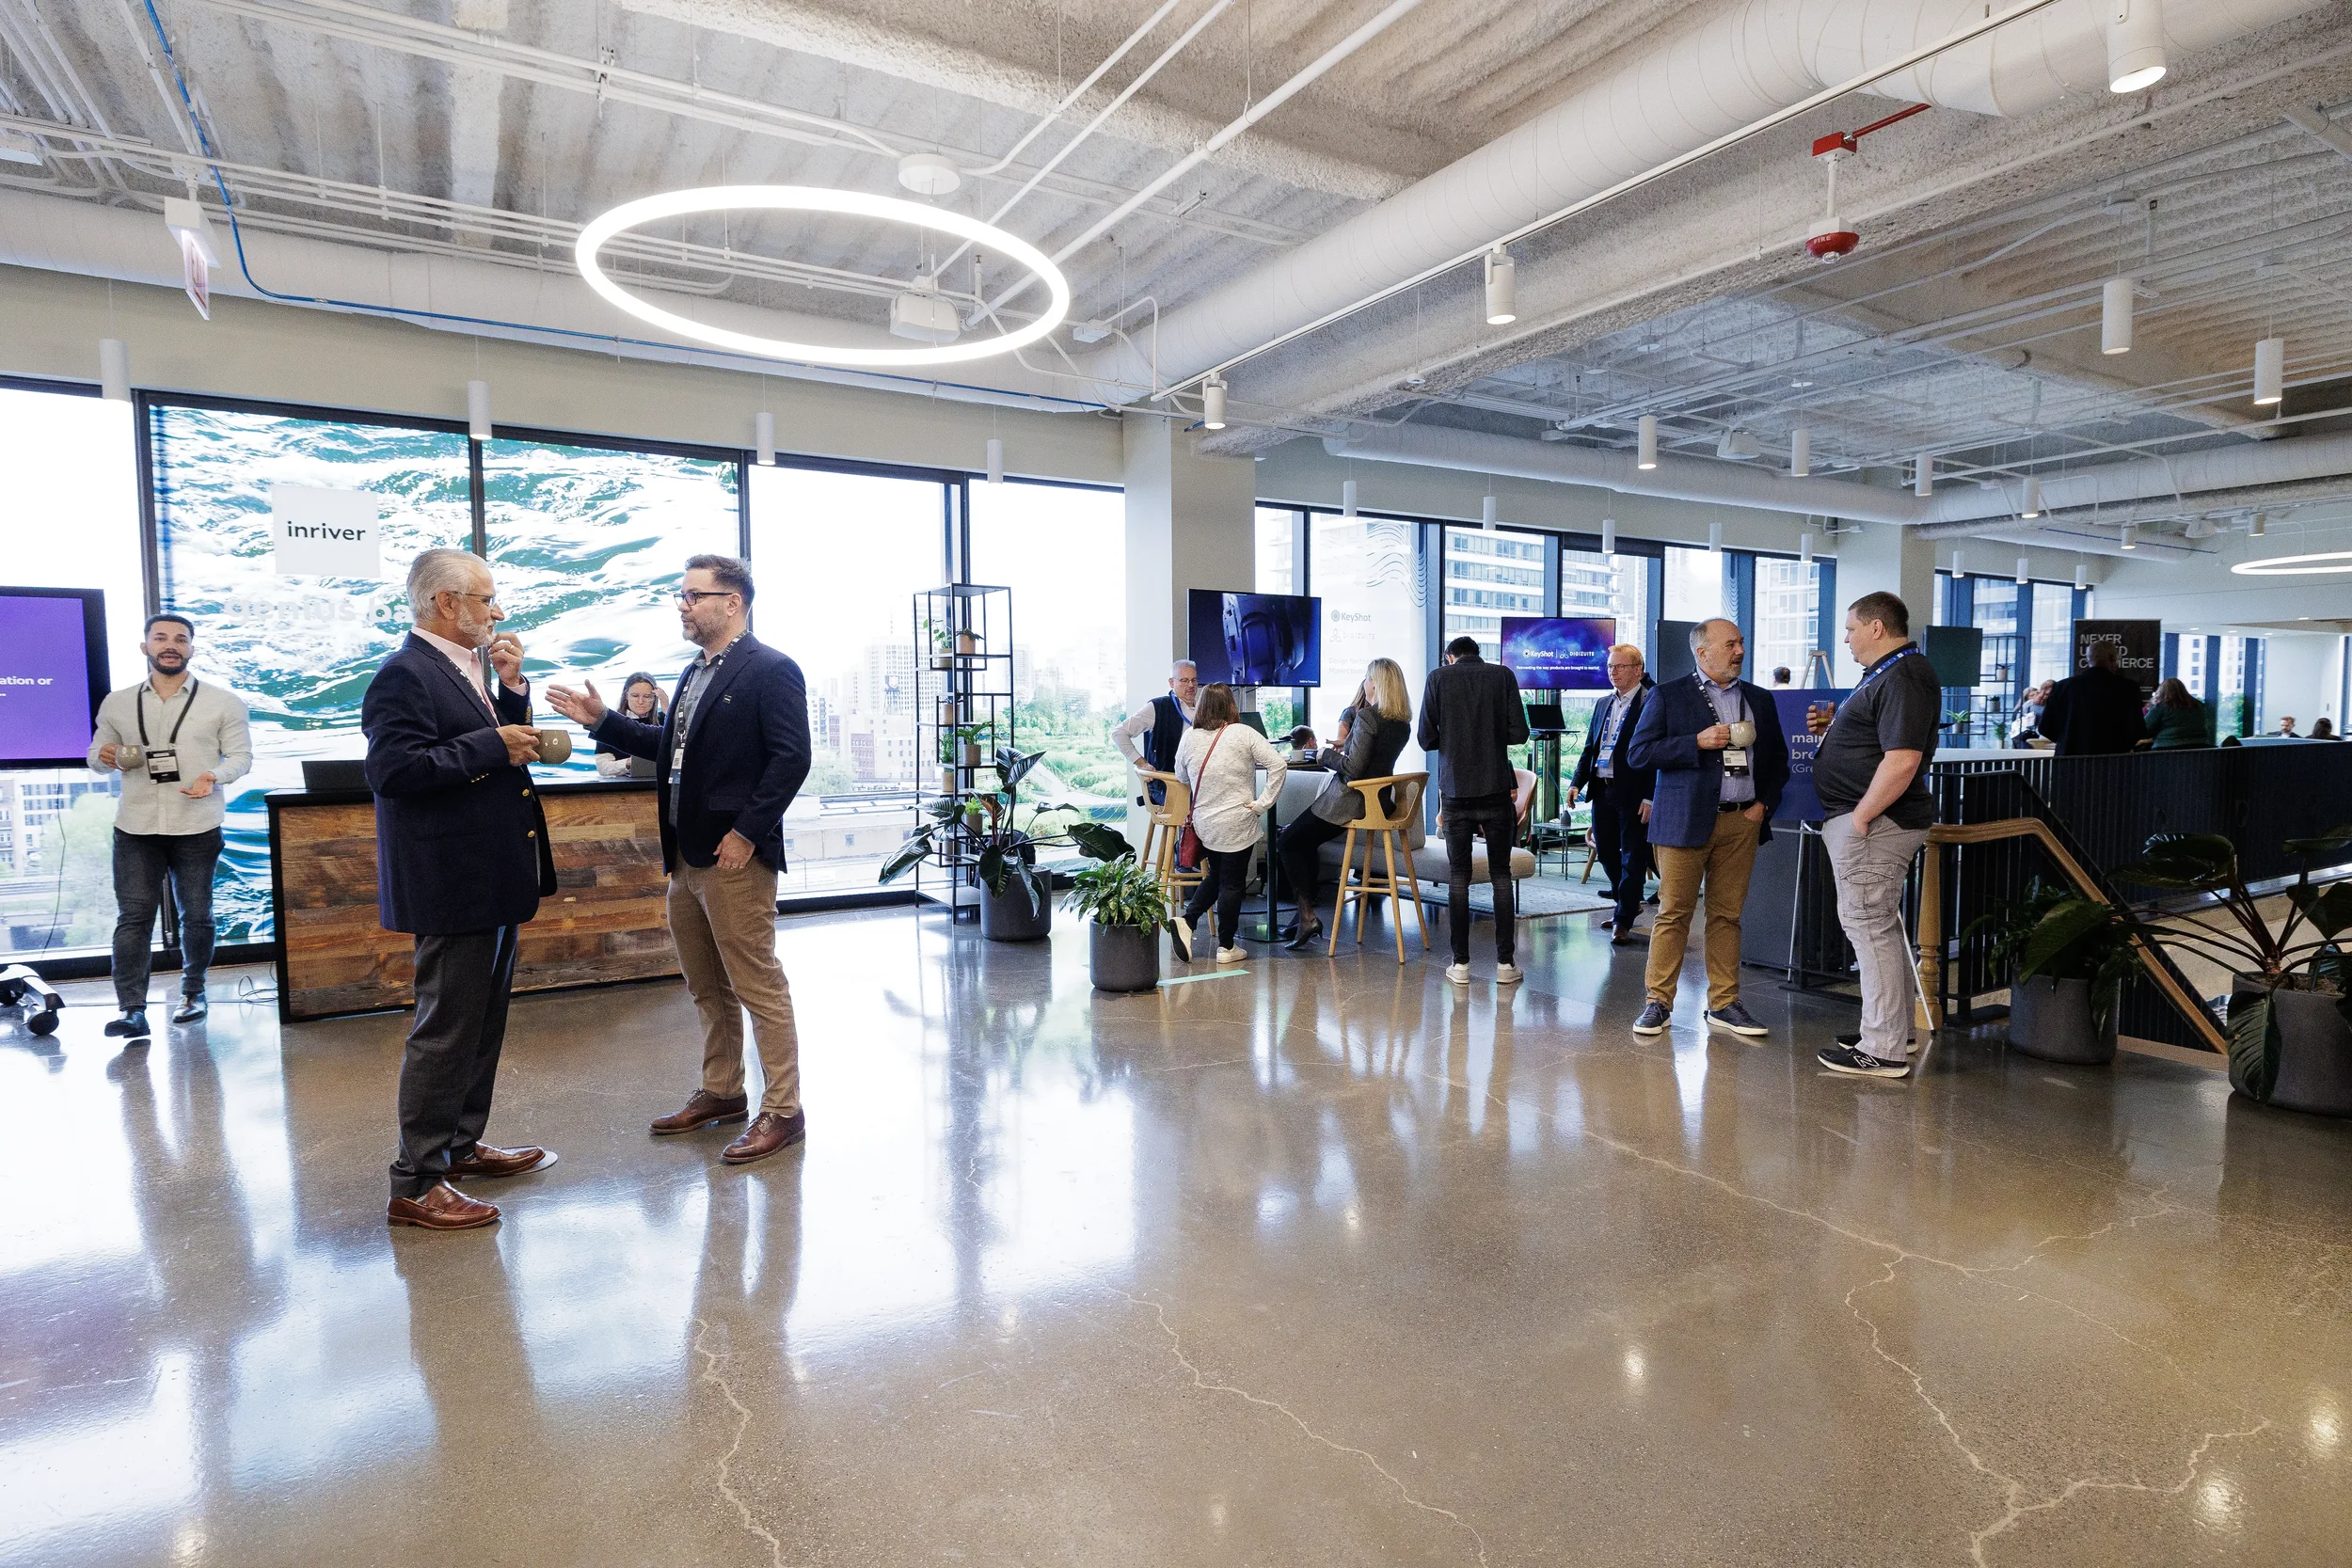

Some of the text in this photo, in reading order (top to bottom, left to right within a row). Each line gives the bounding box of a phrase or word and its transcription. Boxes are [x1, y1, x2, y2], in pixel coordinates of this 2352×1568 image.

[1813, 235, 1832, 244] FIRE
[287, 520, 366, 541] inriver
[224, 594, 356, 626] genius
[1341, 612, 1371, 623] KeyShot
[2078, 657, 2154, 669] CERCE
[37, 677, 54, 686] or
